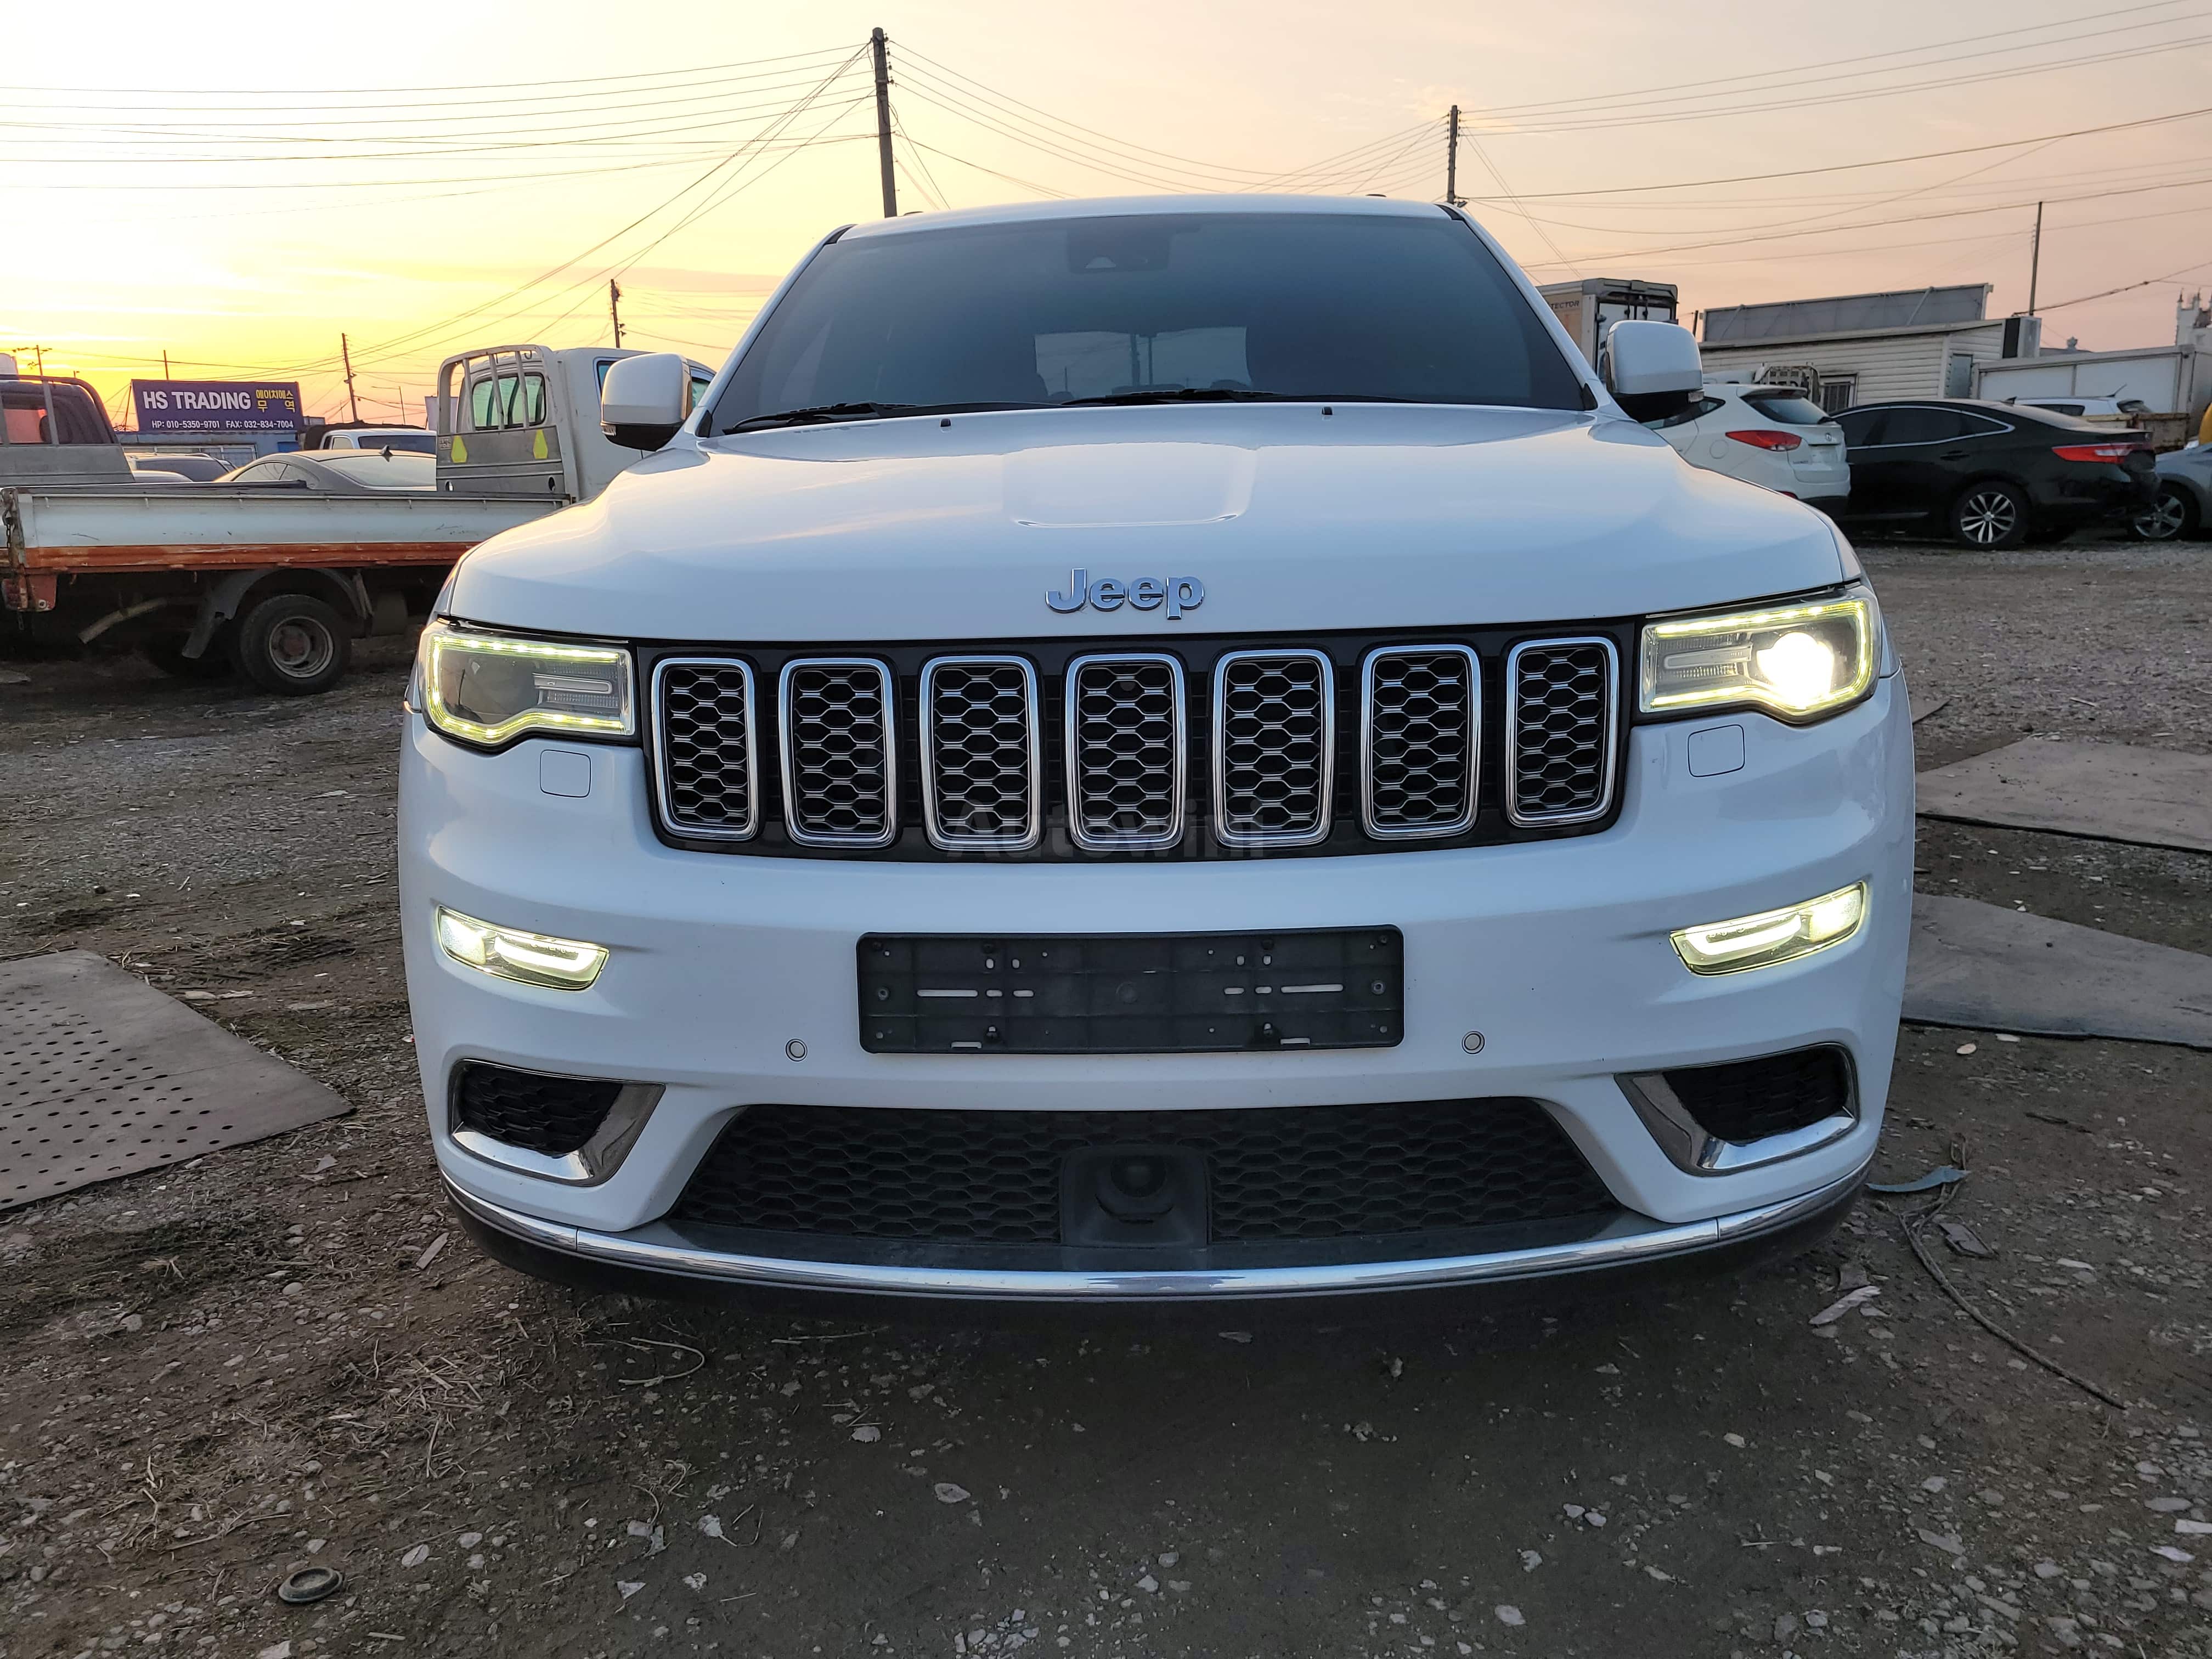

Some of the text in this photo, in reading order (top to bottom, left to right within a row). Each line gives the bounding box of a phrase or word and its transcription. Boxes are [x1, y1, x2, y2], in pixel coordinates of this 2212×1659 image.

[256, 390, 294, 399] 에이치에스
[143, 391, 251, 410] HS TRADING
[151, 420, 220, 428] HP: 010-5350-9701
[225, 420, 294, 428] FAX: 032-834-7004
[1045, 567, 1205, 620] Jeep
